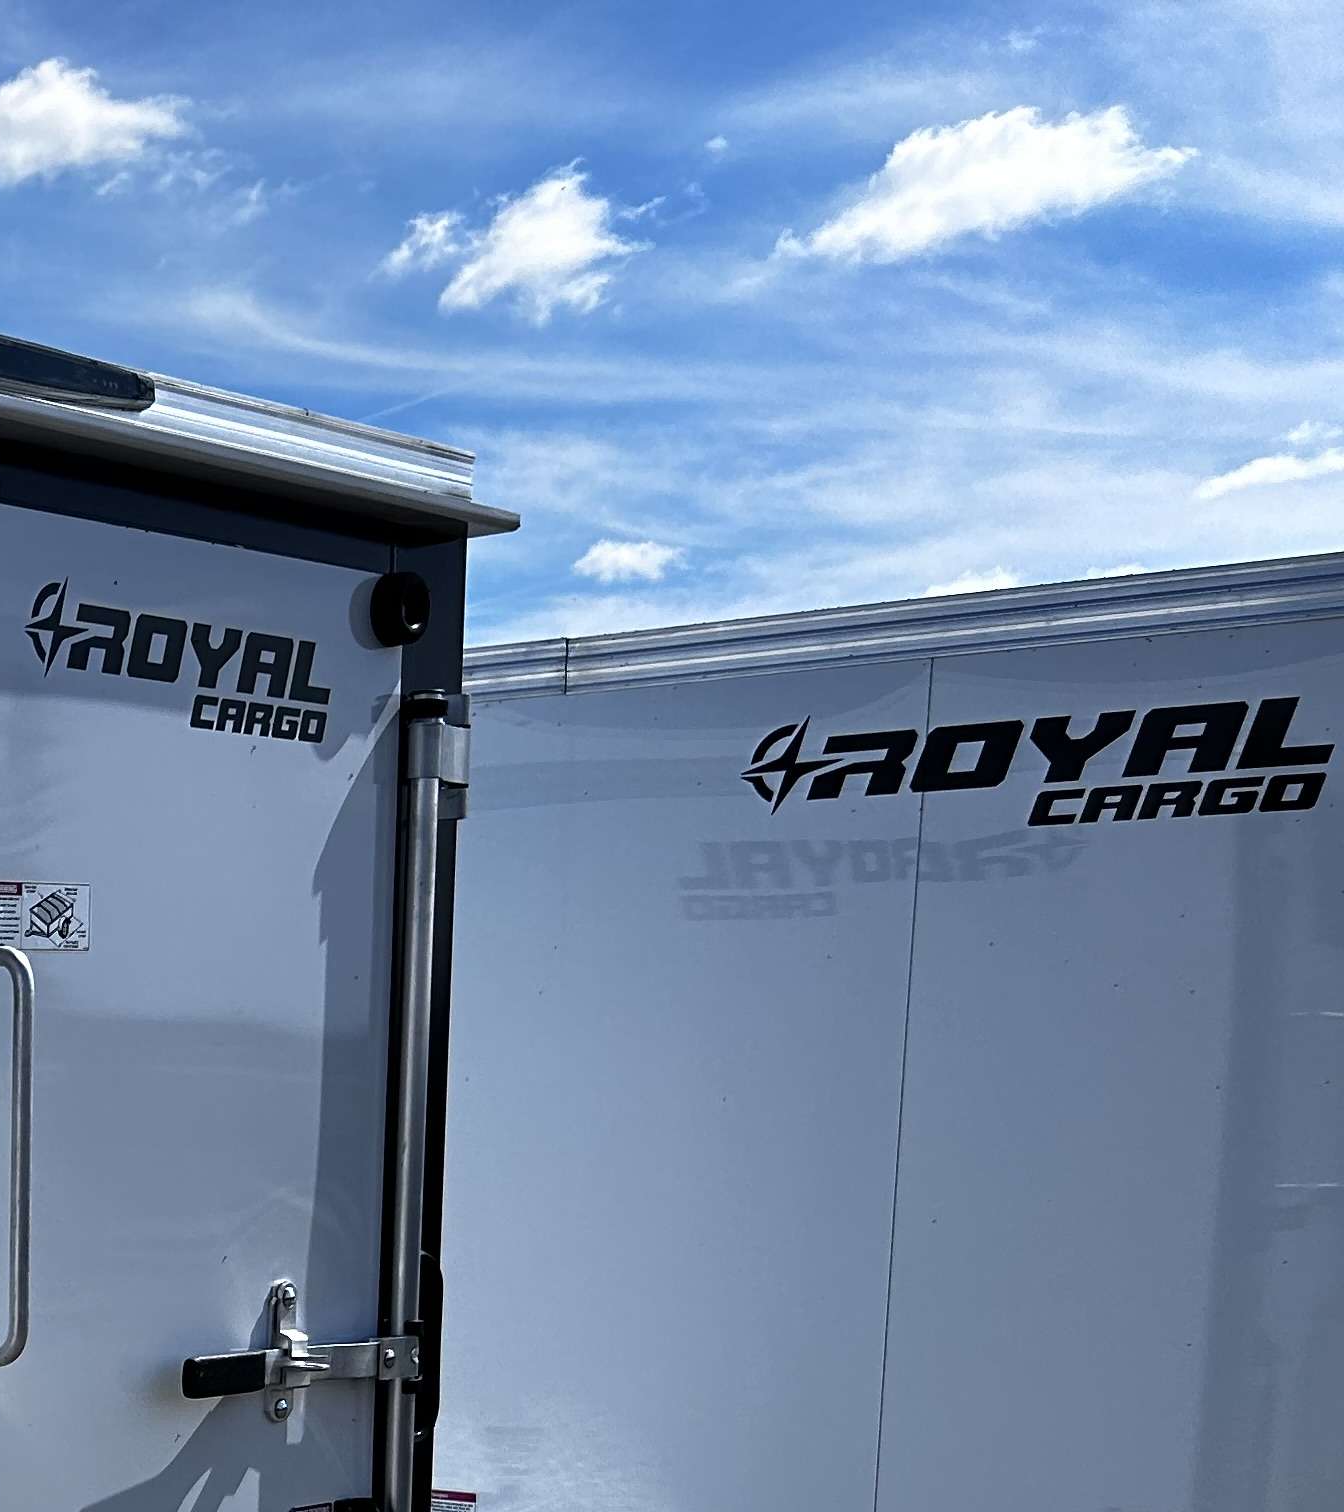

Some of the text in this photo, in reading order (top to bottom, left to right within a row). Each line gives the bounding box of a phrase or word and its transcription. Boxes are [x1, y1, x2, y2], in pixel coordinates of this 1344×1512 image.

[67, 603, 331, 705] ROYAL
[189, 694, 327, 743] CARGO
[806, 696, 1335, 800] ROYAL
[1027, 772, 1327, 827] CARGO
